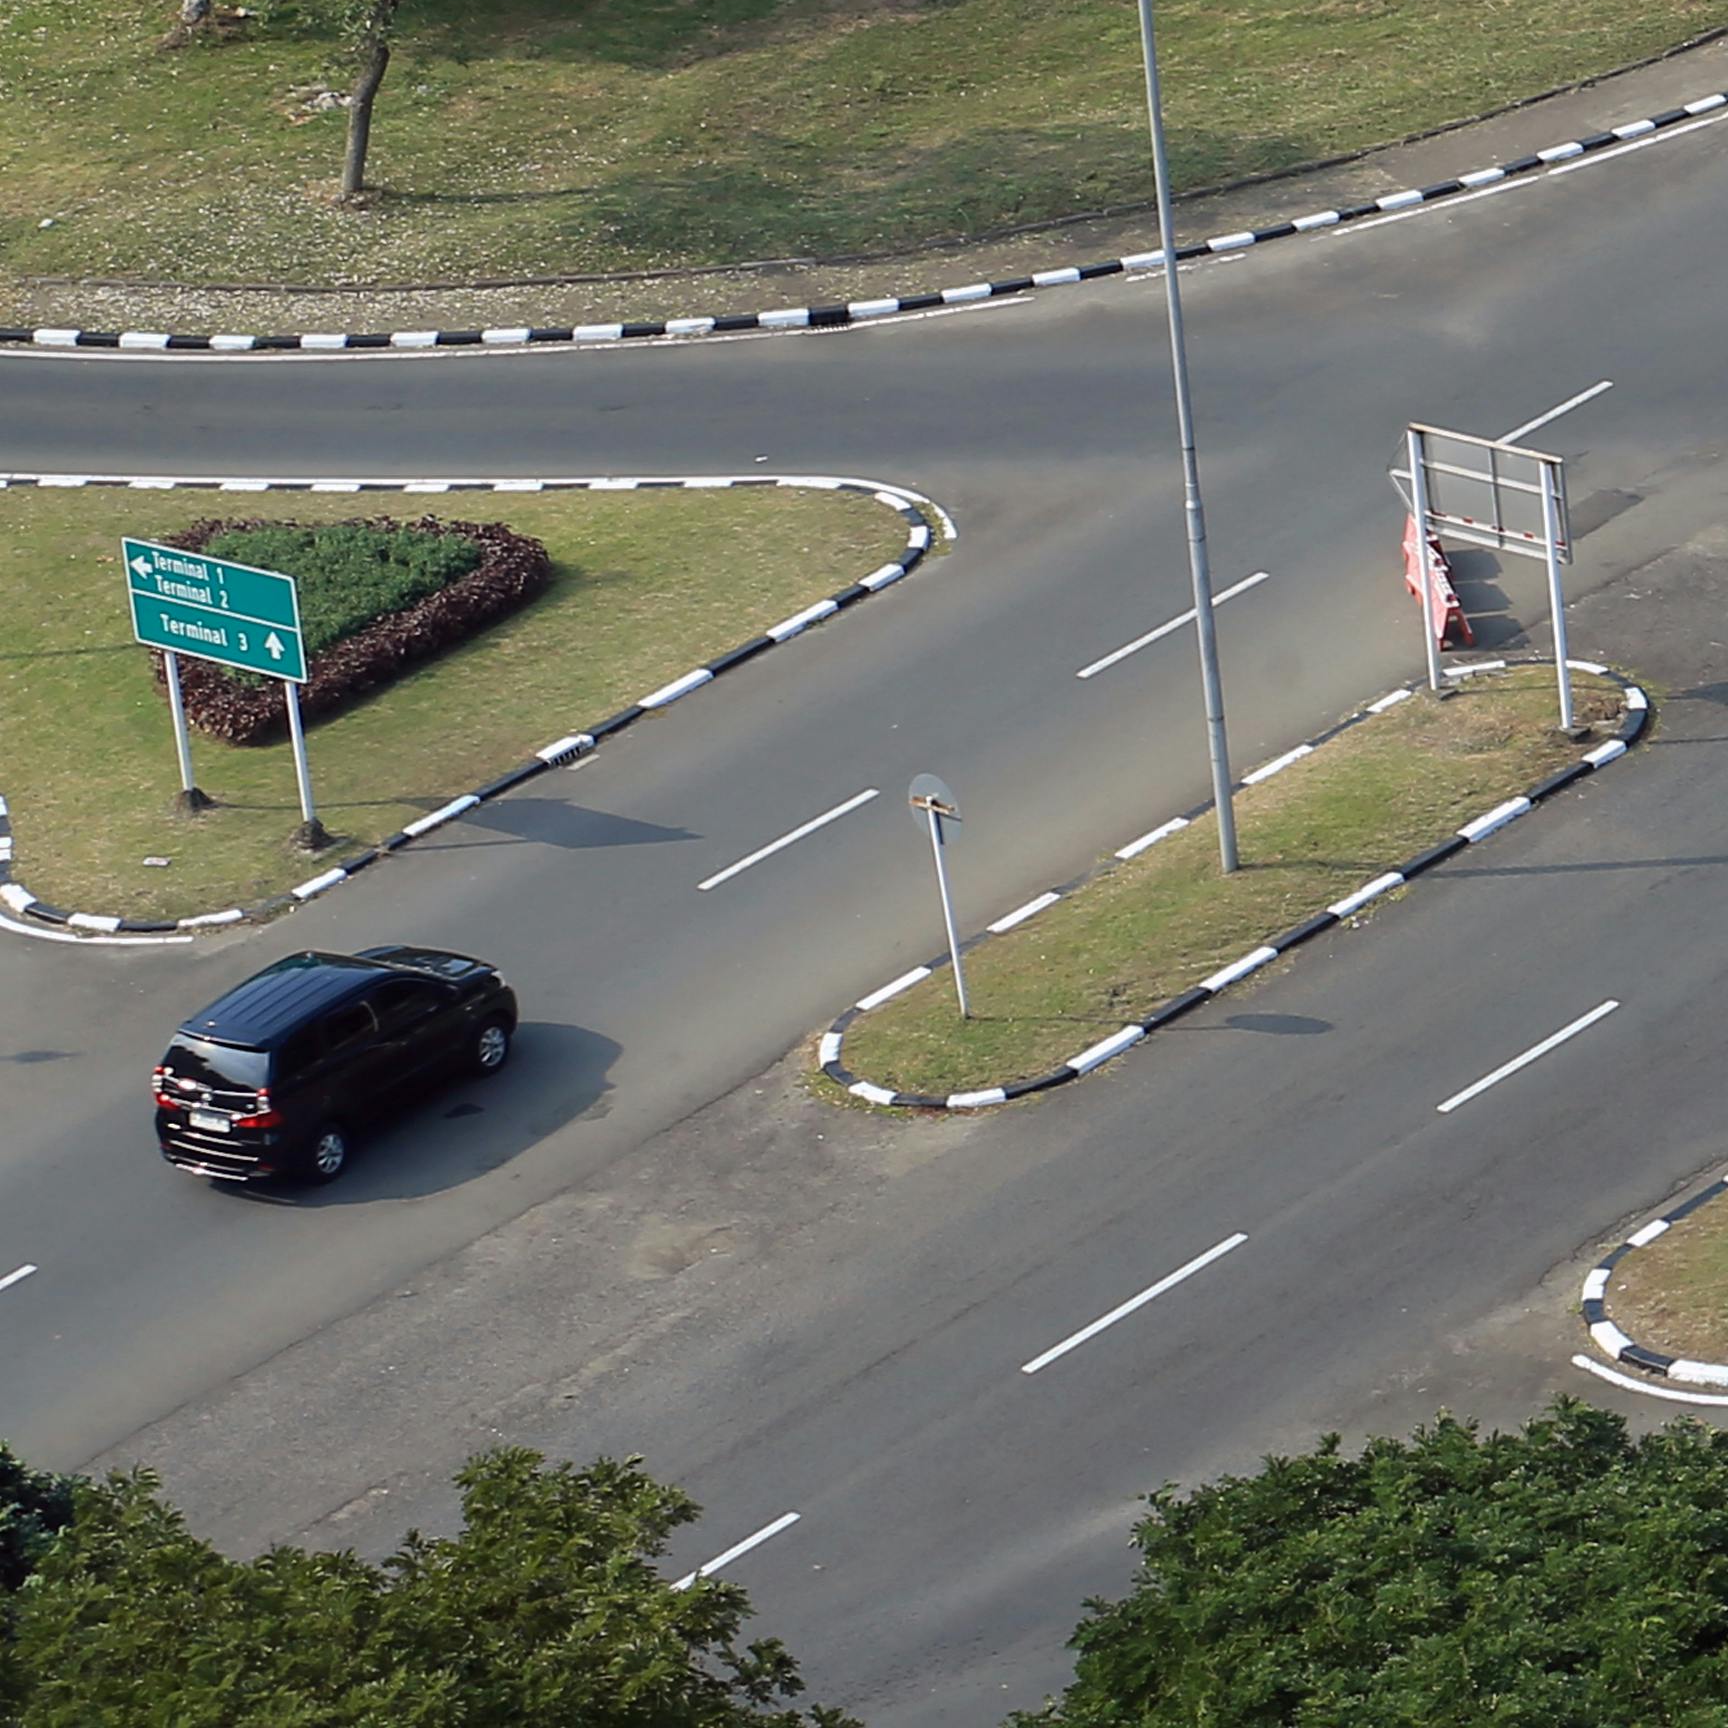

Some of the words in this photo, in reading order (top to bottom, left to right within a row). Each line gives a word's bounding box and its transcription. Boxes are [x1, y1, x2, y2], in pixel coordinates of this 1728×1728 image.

[151, 551, 209, 581] Terminal
[216, 567, 224, 584] 1
[154, 575, 213, 604] Terminal
[219, 590, 229, 608] 2
[160, 613, 228, 647] Terminal
[238, 633, 248, 651] 3
